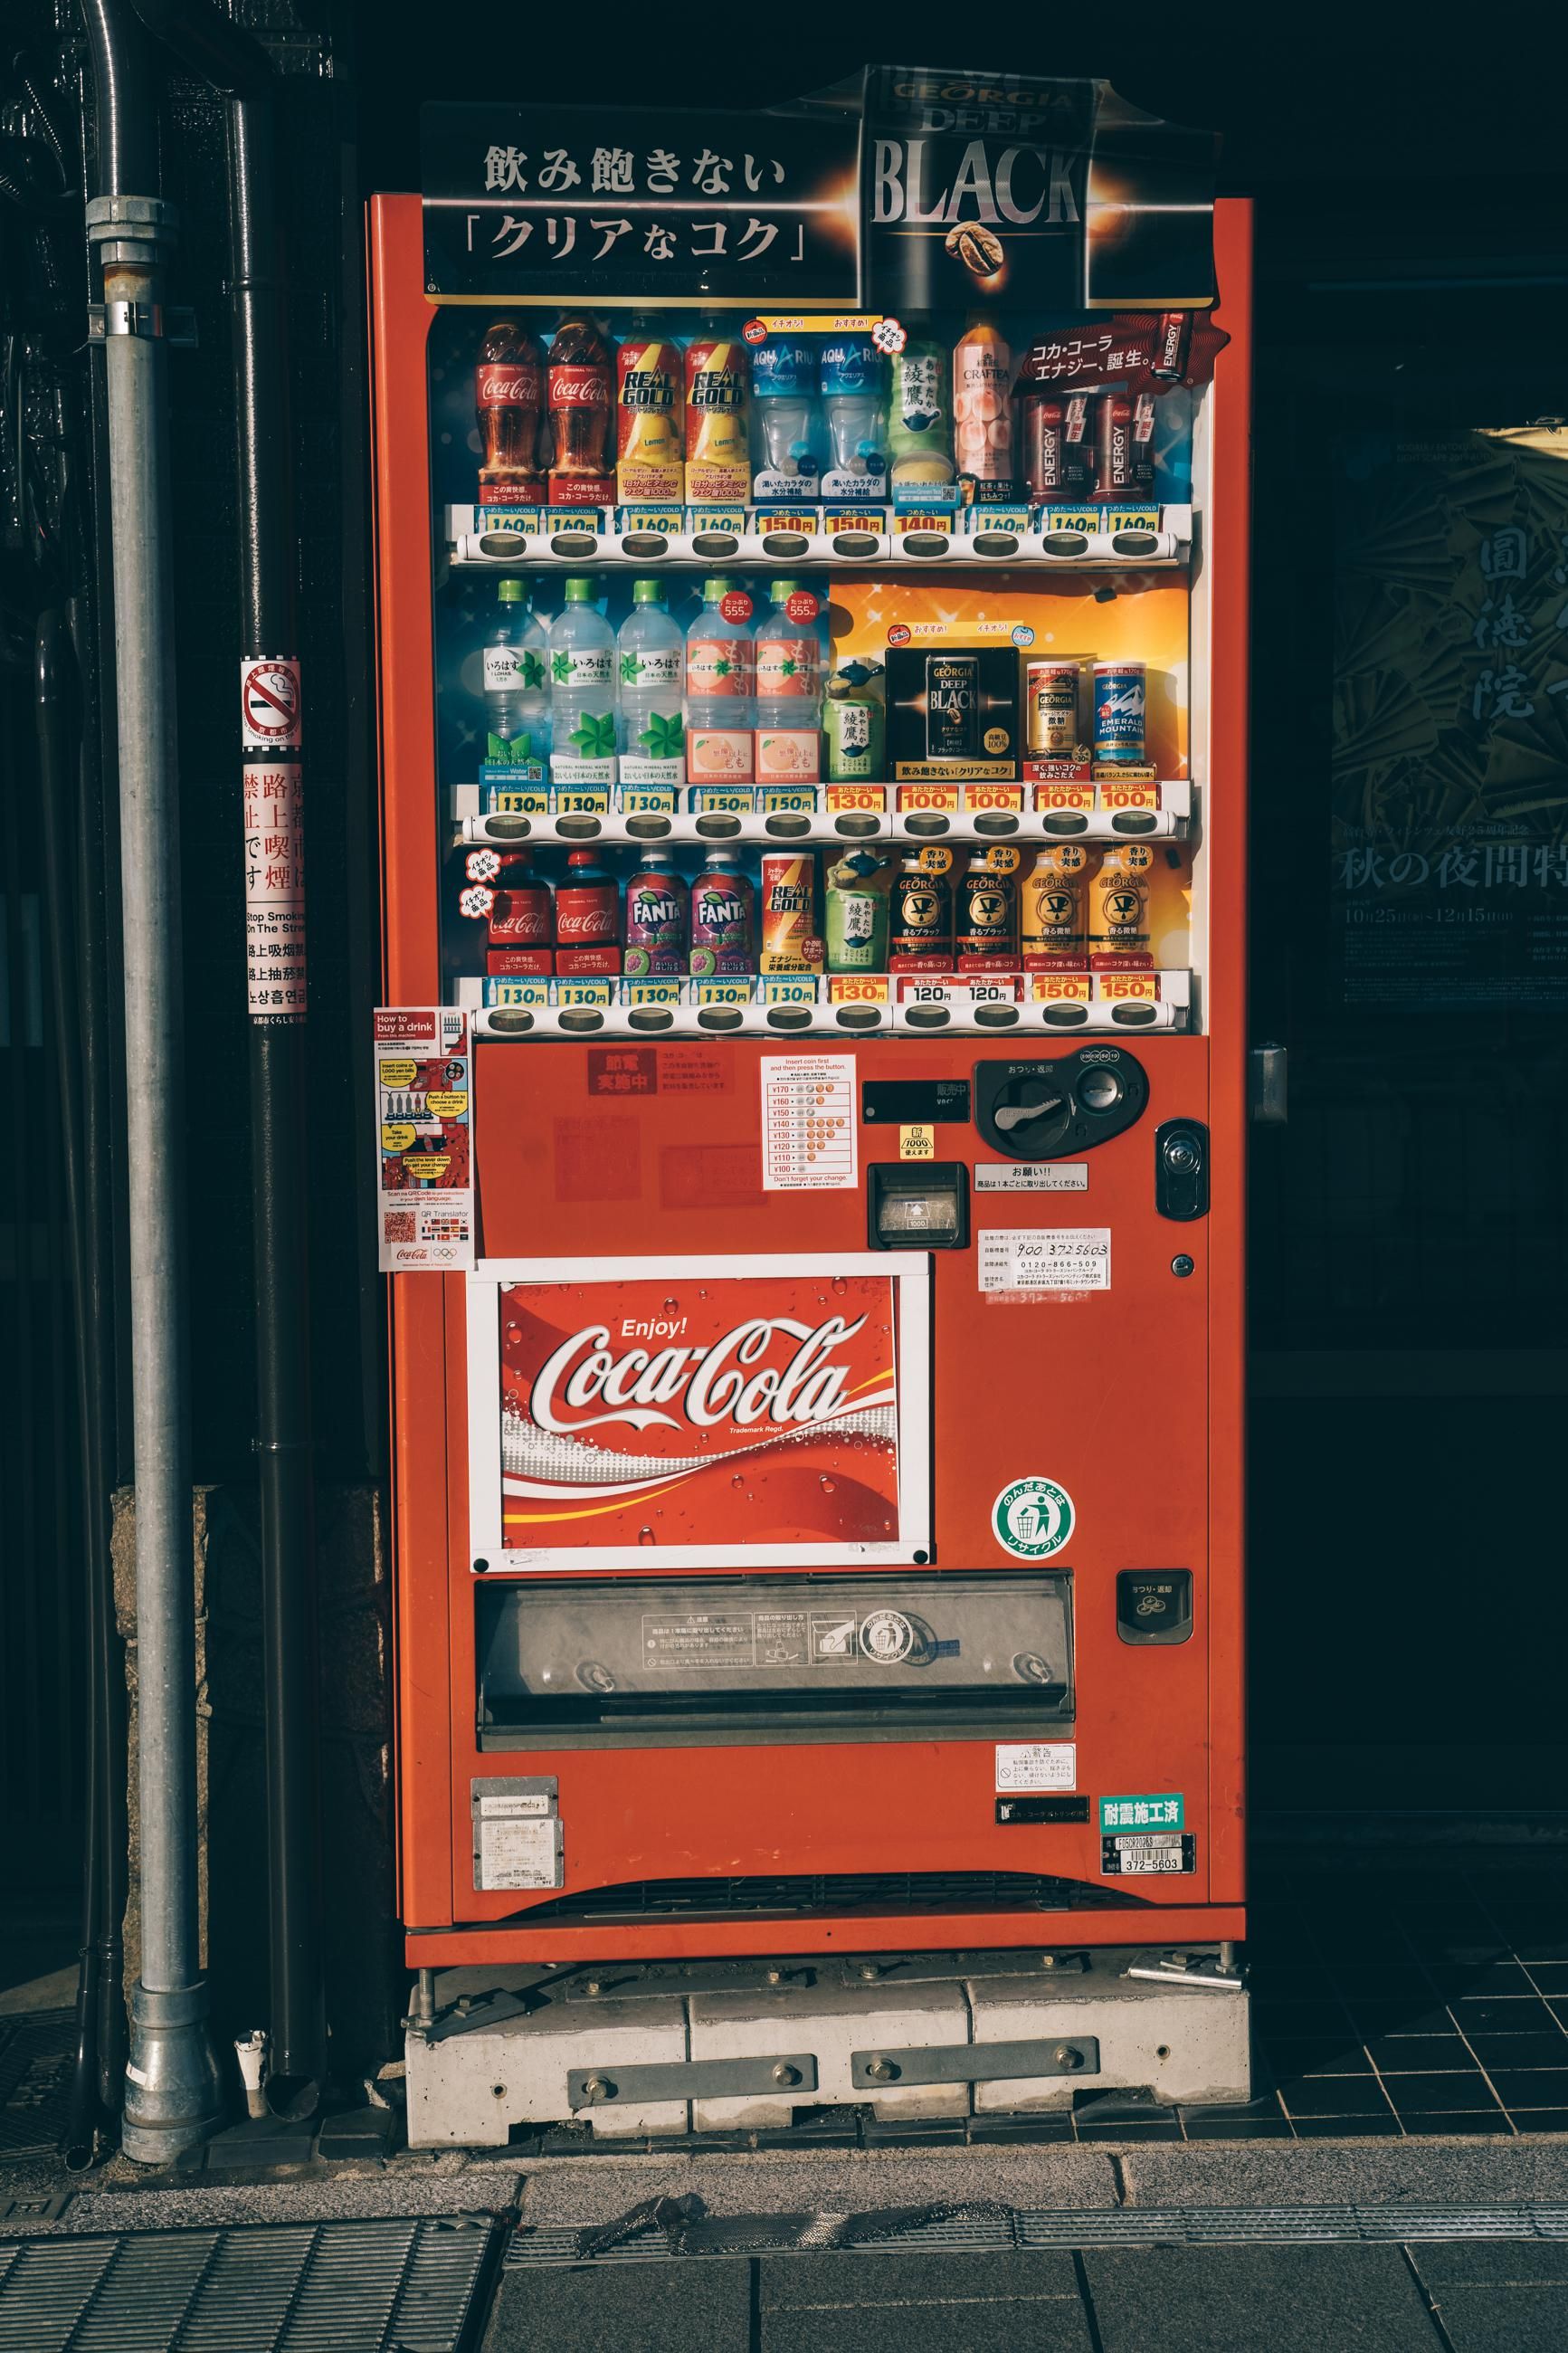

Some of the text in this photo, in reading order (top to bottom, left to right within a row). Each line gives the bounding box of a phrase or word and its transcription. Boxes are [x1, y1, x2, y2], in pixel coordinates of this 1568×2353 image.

[893, 79, 1077, 110] GEORGIA
[917, 105, 1047, 135] DEEP
[483, 144, 786, 195] 飲み飽きない
[873, 138, 1082, 226] BLACK
[464, 213, 805, 263] 「クリアなコク」
[1164, 324, 1178, 367] ENERGY
[623, 366, 674, 389] REAL
[964, 368, 1011, 381] CRAFTEA
[482, 376, 537, 401] Coca-Cola
[553, 377, 608, 401] Coca-Cola
[622, 388, 674, 407] GOLD
[1044, 428, 1056, 486] ENERGY
[1113, 426, 1125, 484] ENERGY
[492, 518, 536, 532] 160円
[553, 518, 594, 532] 160円
[636, 518, 679, 532] 160円
[699, 518, 742, 531] 160円
[762, 517, 813, 531] 150円
[829, 517, 879, 531] 150円
[898, 517, 946, 531] 140円
[984, 518, 1025, 532] 160円
[1055, 517, 1097, 532] 160円
[1114, 517, 1155, 531] 160円
[933, 665, 974, 678] GEORGIA
[940, 680, 967, 690] DEEP
[1101, 681, 1127, 690] GEORGIA
[930, 690, 977, 710] BLACK
[1040, 693, 1072, 704] GEORGIA
[1099, 725, 1144, 736] MOUNTAIN
[1101, 718, 1143, 727] EMERALD
[1039, 771, 1075, 779] 飲みごたえ
[503, 796, 546, 813] 130円
[563, 796, 605, 813] 130円
[630, 795, 671, 812] 130円
[708, 797, 750, 812] 150円
[770, 796, 812, 811] 150円
[830, 794, 881, 809] 130円
[903, 793, 955, 809] 100円
[966, 793, 1018, 809] 100円
[1040, 792, 1091, 809] 100円
[1102, 791, 1154, 807] 100円
[262, 773, 290, 891] 路上喫煙
[925, 849, 946, 859] 香り
[771, 880, 811, 899] REAL
[633, 900, 680, 925] FANTA
[698, 900, 746, 924] FANTA
[771, 898, 811, 912] GOLD
[247, 911, 305, 923] Stop Smokin
[557, 910, 613, 934] Coca-Cola
[257, 924, 279, 933] The
[503, 988, 545, 1004] 130円
[564, 989, 606, 1005] 130円
[636, 988, 679, 1004] 130円
[705, 988, 747, 1004] 130円
[771, 987, 813, 1002] 130円
[833, 985, 885, 1001] 130円
[913, 986, 952, 1002] 120円
[968, 986, 1007, 1002] 120円
[1036, 983, 1087, 999] 150円
[1102, 982, 1154, 998] 150円
[377, 1024, 397, 1034] buy
[406, 1022, 432, 1032] drink
[911, 1127, 924, 1138] 新
[905, 1139, 929, 1148] 1000
[396, 1249, 428, 1260] Coca-Cola
[1016, 1243, 1042, 1258] 900
[621, 1317, 688, 1338] Enjoy!
[530, 1311, 870, 1433] Coca-Cola
[1003, 1481, 1066, 1507] のんだあとは
[1006, 1535, 1062, 1555] リサイクル
[1104, 1800, 1179, 1826] 耐震施工済
[1126, 1859, 1178, 1871] 372-5603
